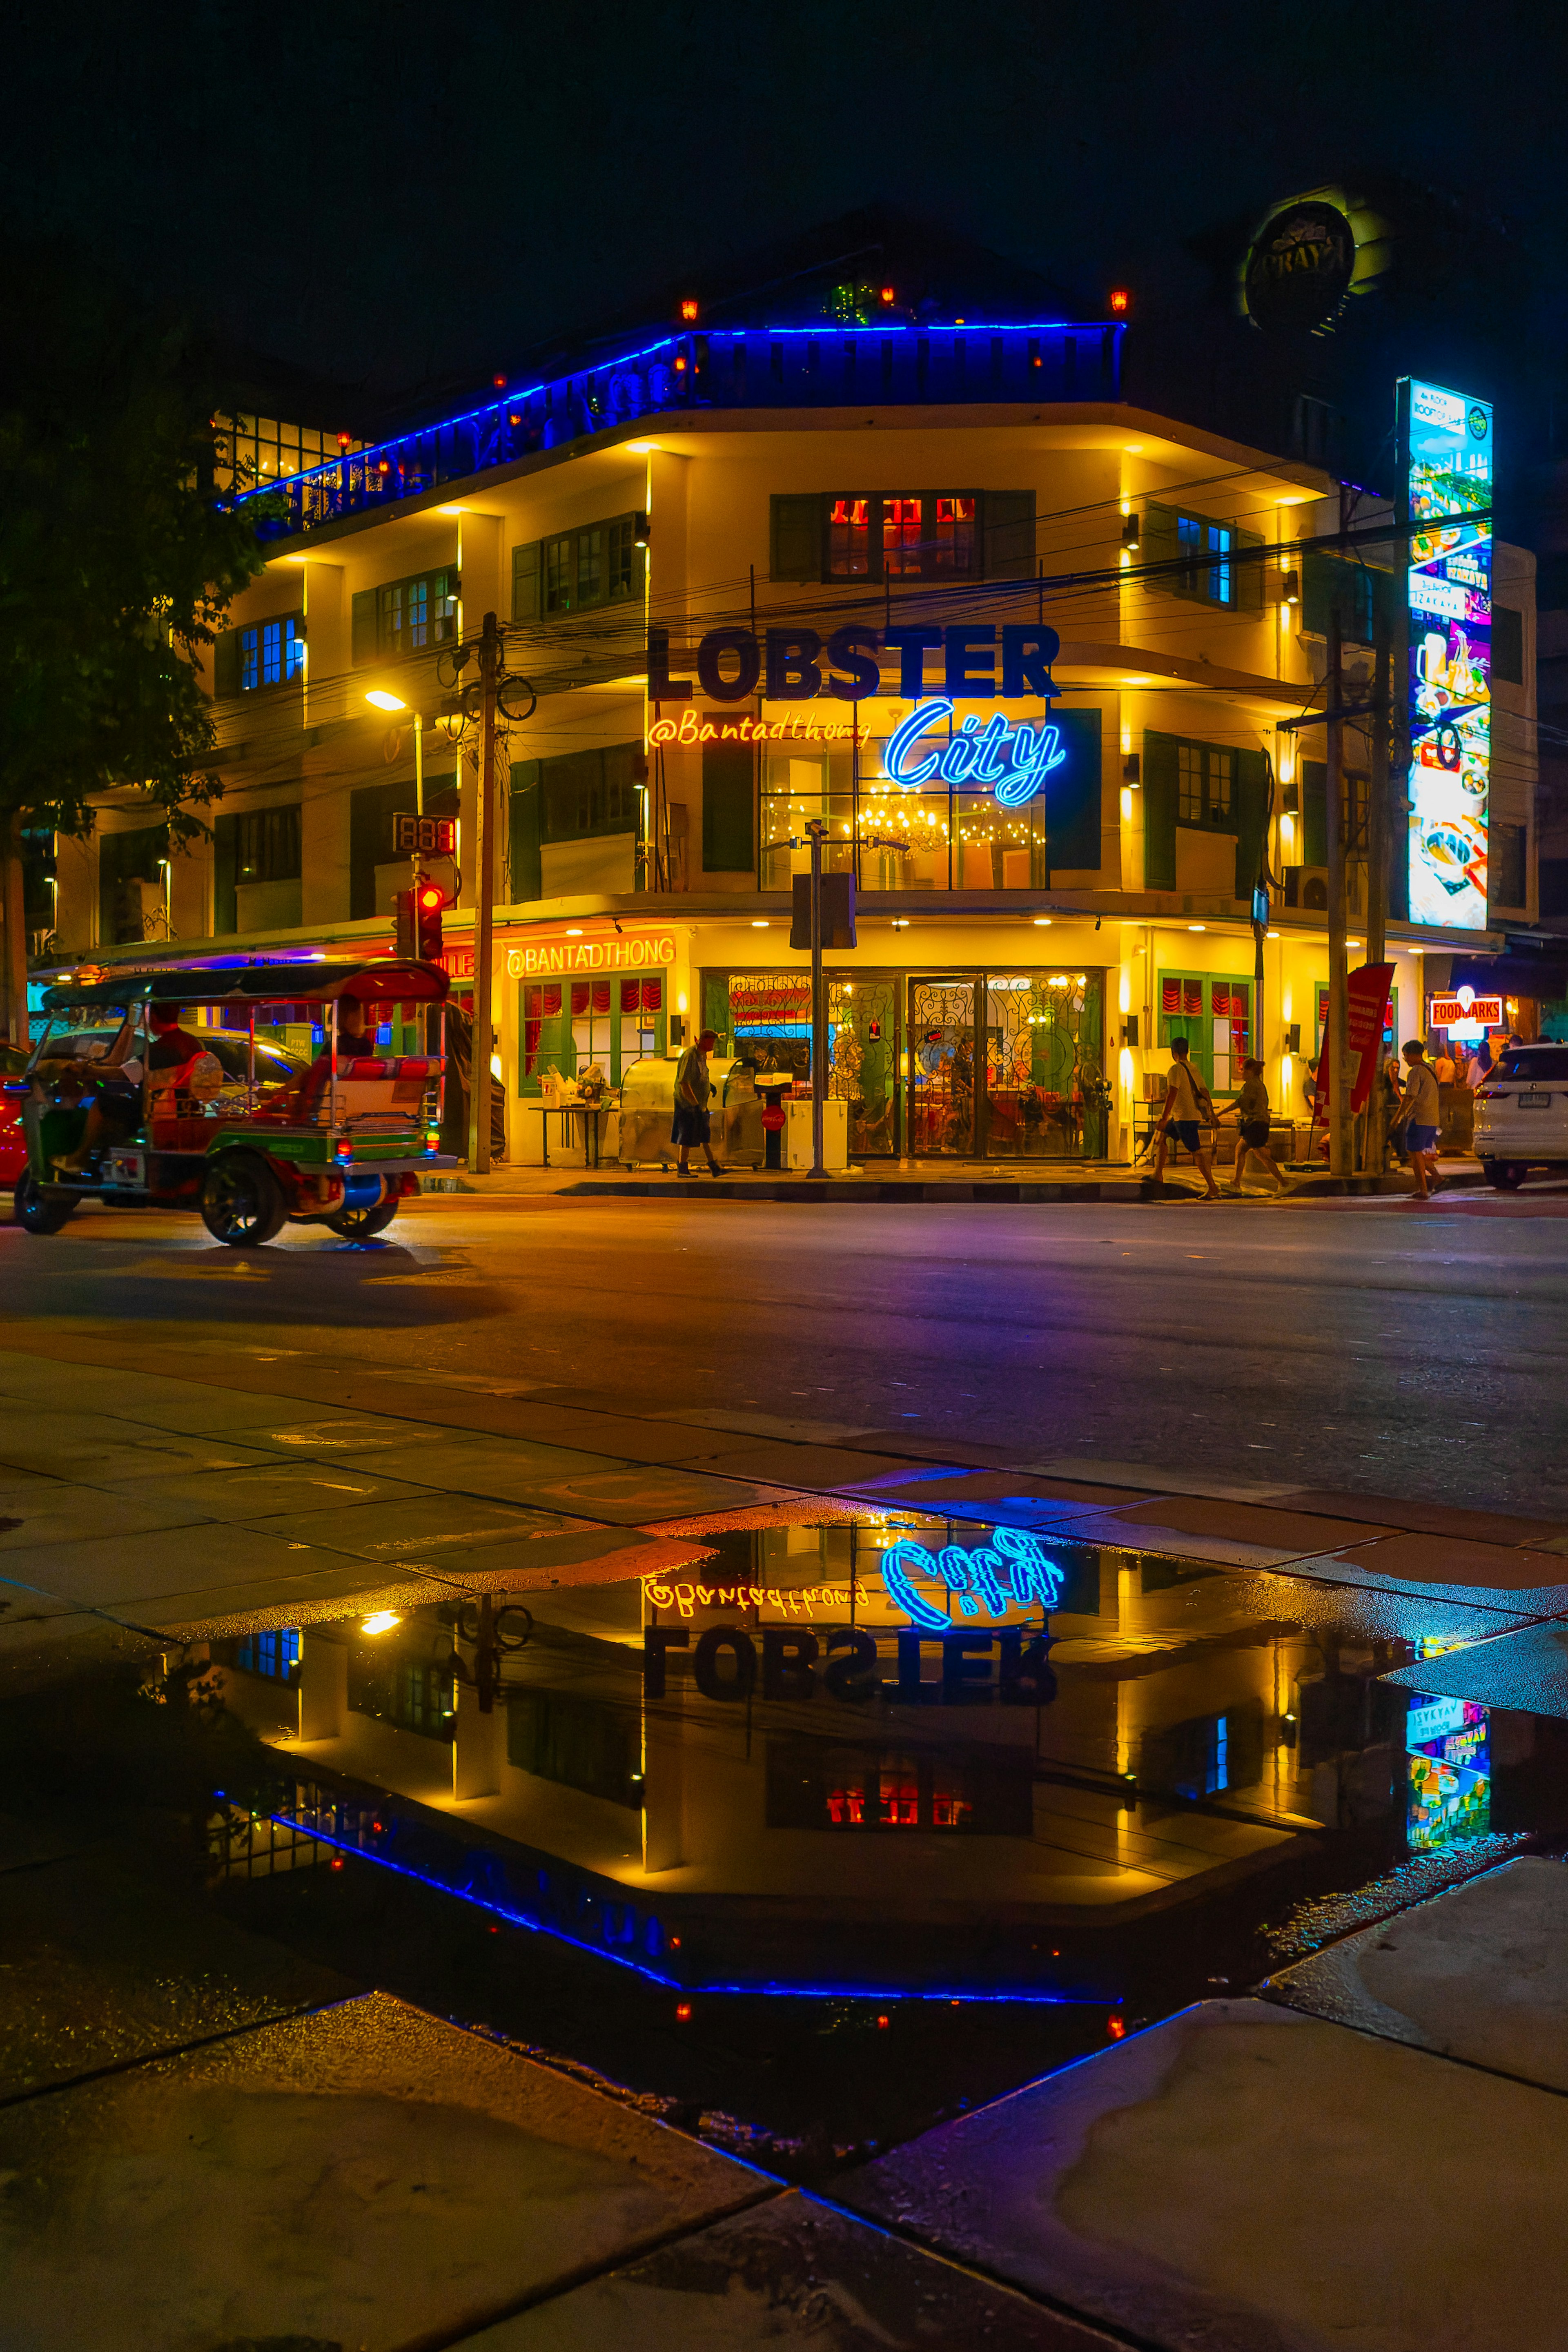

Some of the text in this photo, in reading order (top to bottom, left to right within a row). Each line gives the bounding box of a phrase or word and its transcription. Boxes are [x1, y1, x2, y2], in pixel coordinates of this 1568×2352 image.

[648, 624, 1061, 702] LOBSTER
[649, 709, 873, 749] @Bantadthong
[884, 699, 1066, 806] City
[507, 937, 674, 980] @BANTADTHONG
